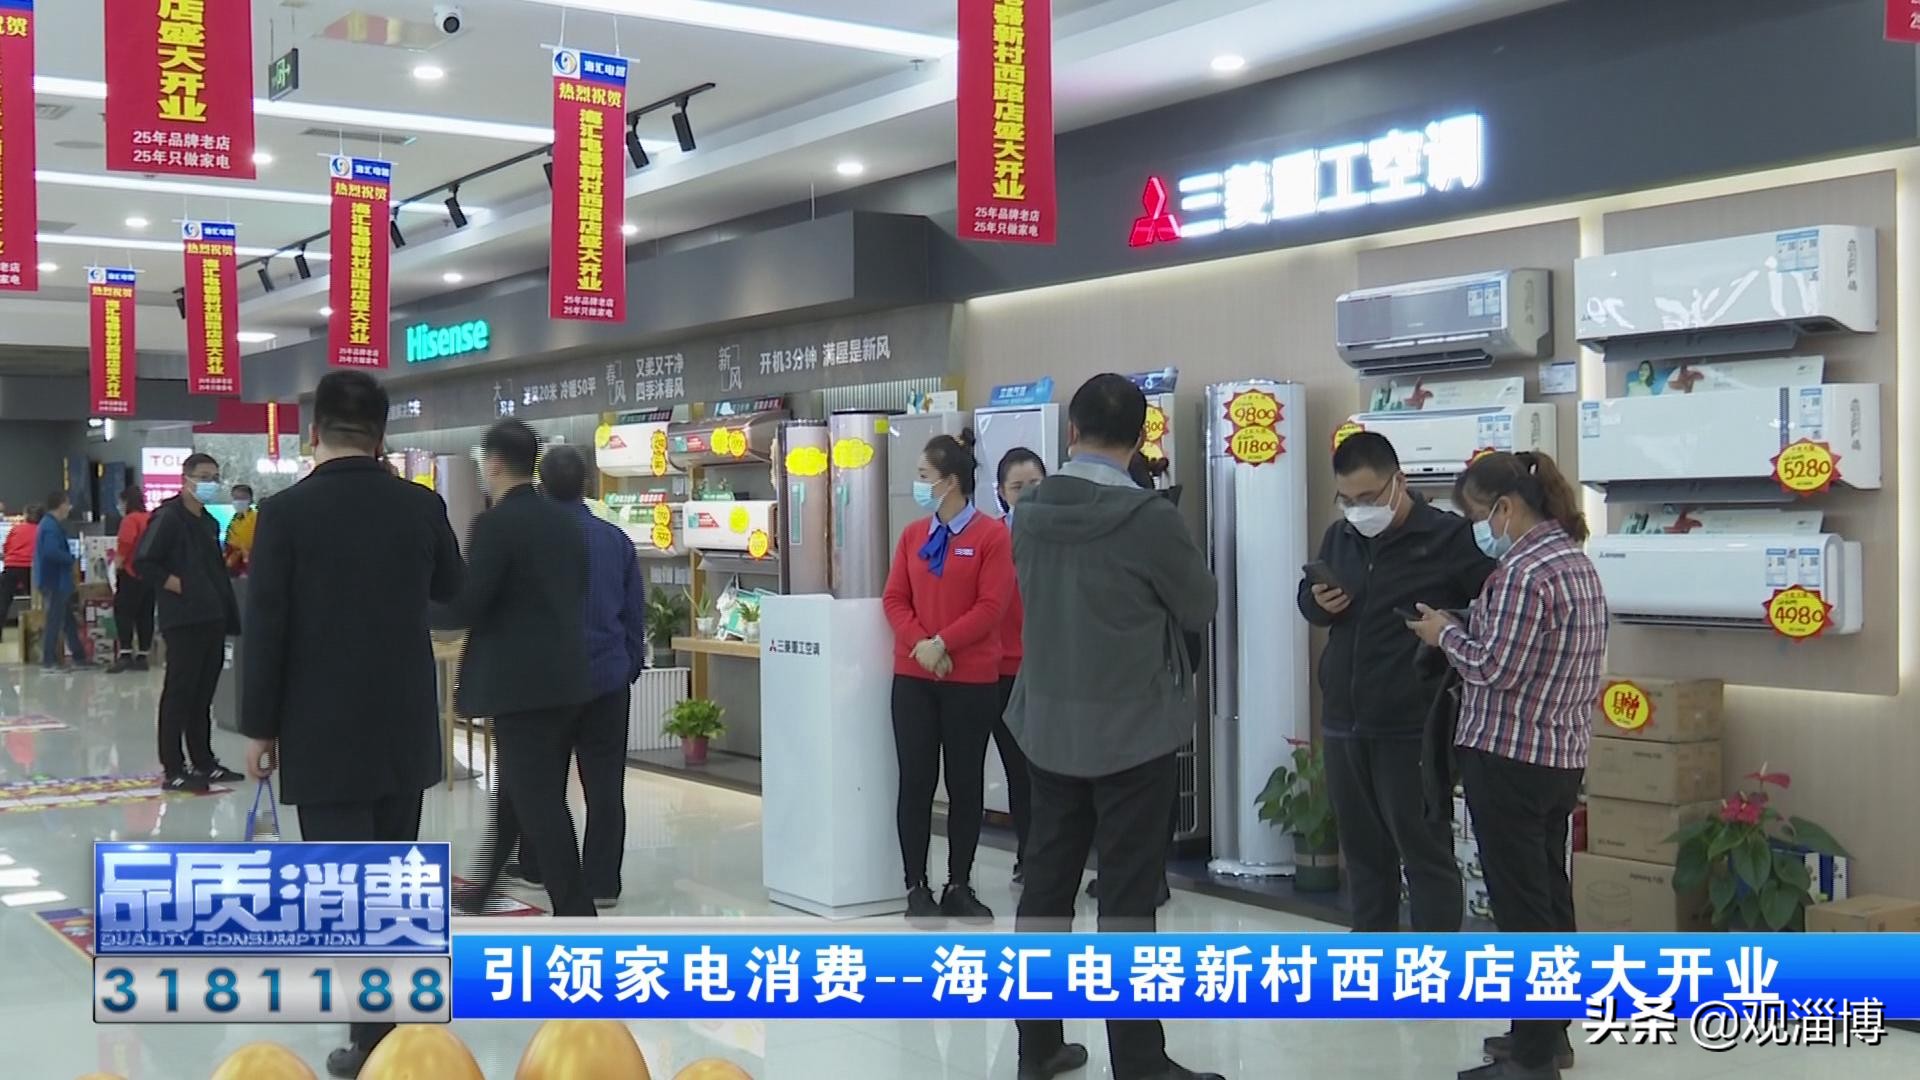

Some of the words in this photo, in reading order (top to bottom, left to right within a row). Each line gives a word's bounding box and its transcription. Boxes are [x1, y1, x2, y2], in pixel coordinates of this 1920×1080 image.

[559, 81, 622, 108] 热烈祝贺
[992, 0, 1025, 200] 器新村西路店盛大开业
[133, 130, 231, 151] 25年品牌老店
[133, 149, 231, 170] 25年只做家电
[335, 182, 388, 201] 热烈祝贺
[577, 108, 604, 291] 海汇电器新村西路店盛大开业
[975, 206, 1040, 223] 25年品牌老店
[974, 221, 1039, 238] 25年只做家电
[350, 202, 372, 344] 海汇电器新村西路店盛大开业
[406, 319, 489, 362] Hisense
[636, 352, 684, 379] 又柔又干净
[759, 346, 817, 375] 开机3分钟
[822, 336, 891, 367] 满屋是新风
[636, 377, 685, 402] 四季沐春风
[1234, 406, 1277, 422] 9800
[1237, 440, 1278, 454] 11800
[1783, 459, 1831, 480] 5280
[1775, 606, 1825, 625] 4980
